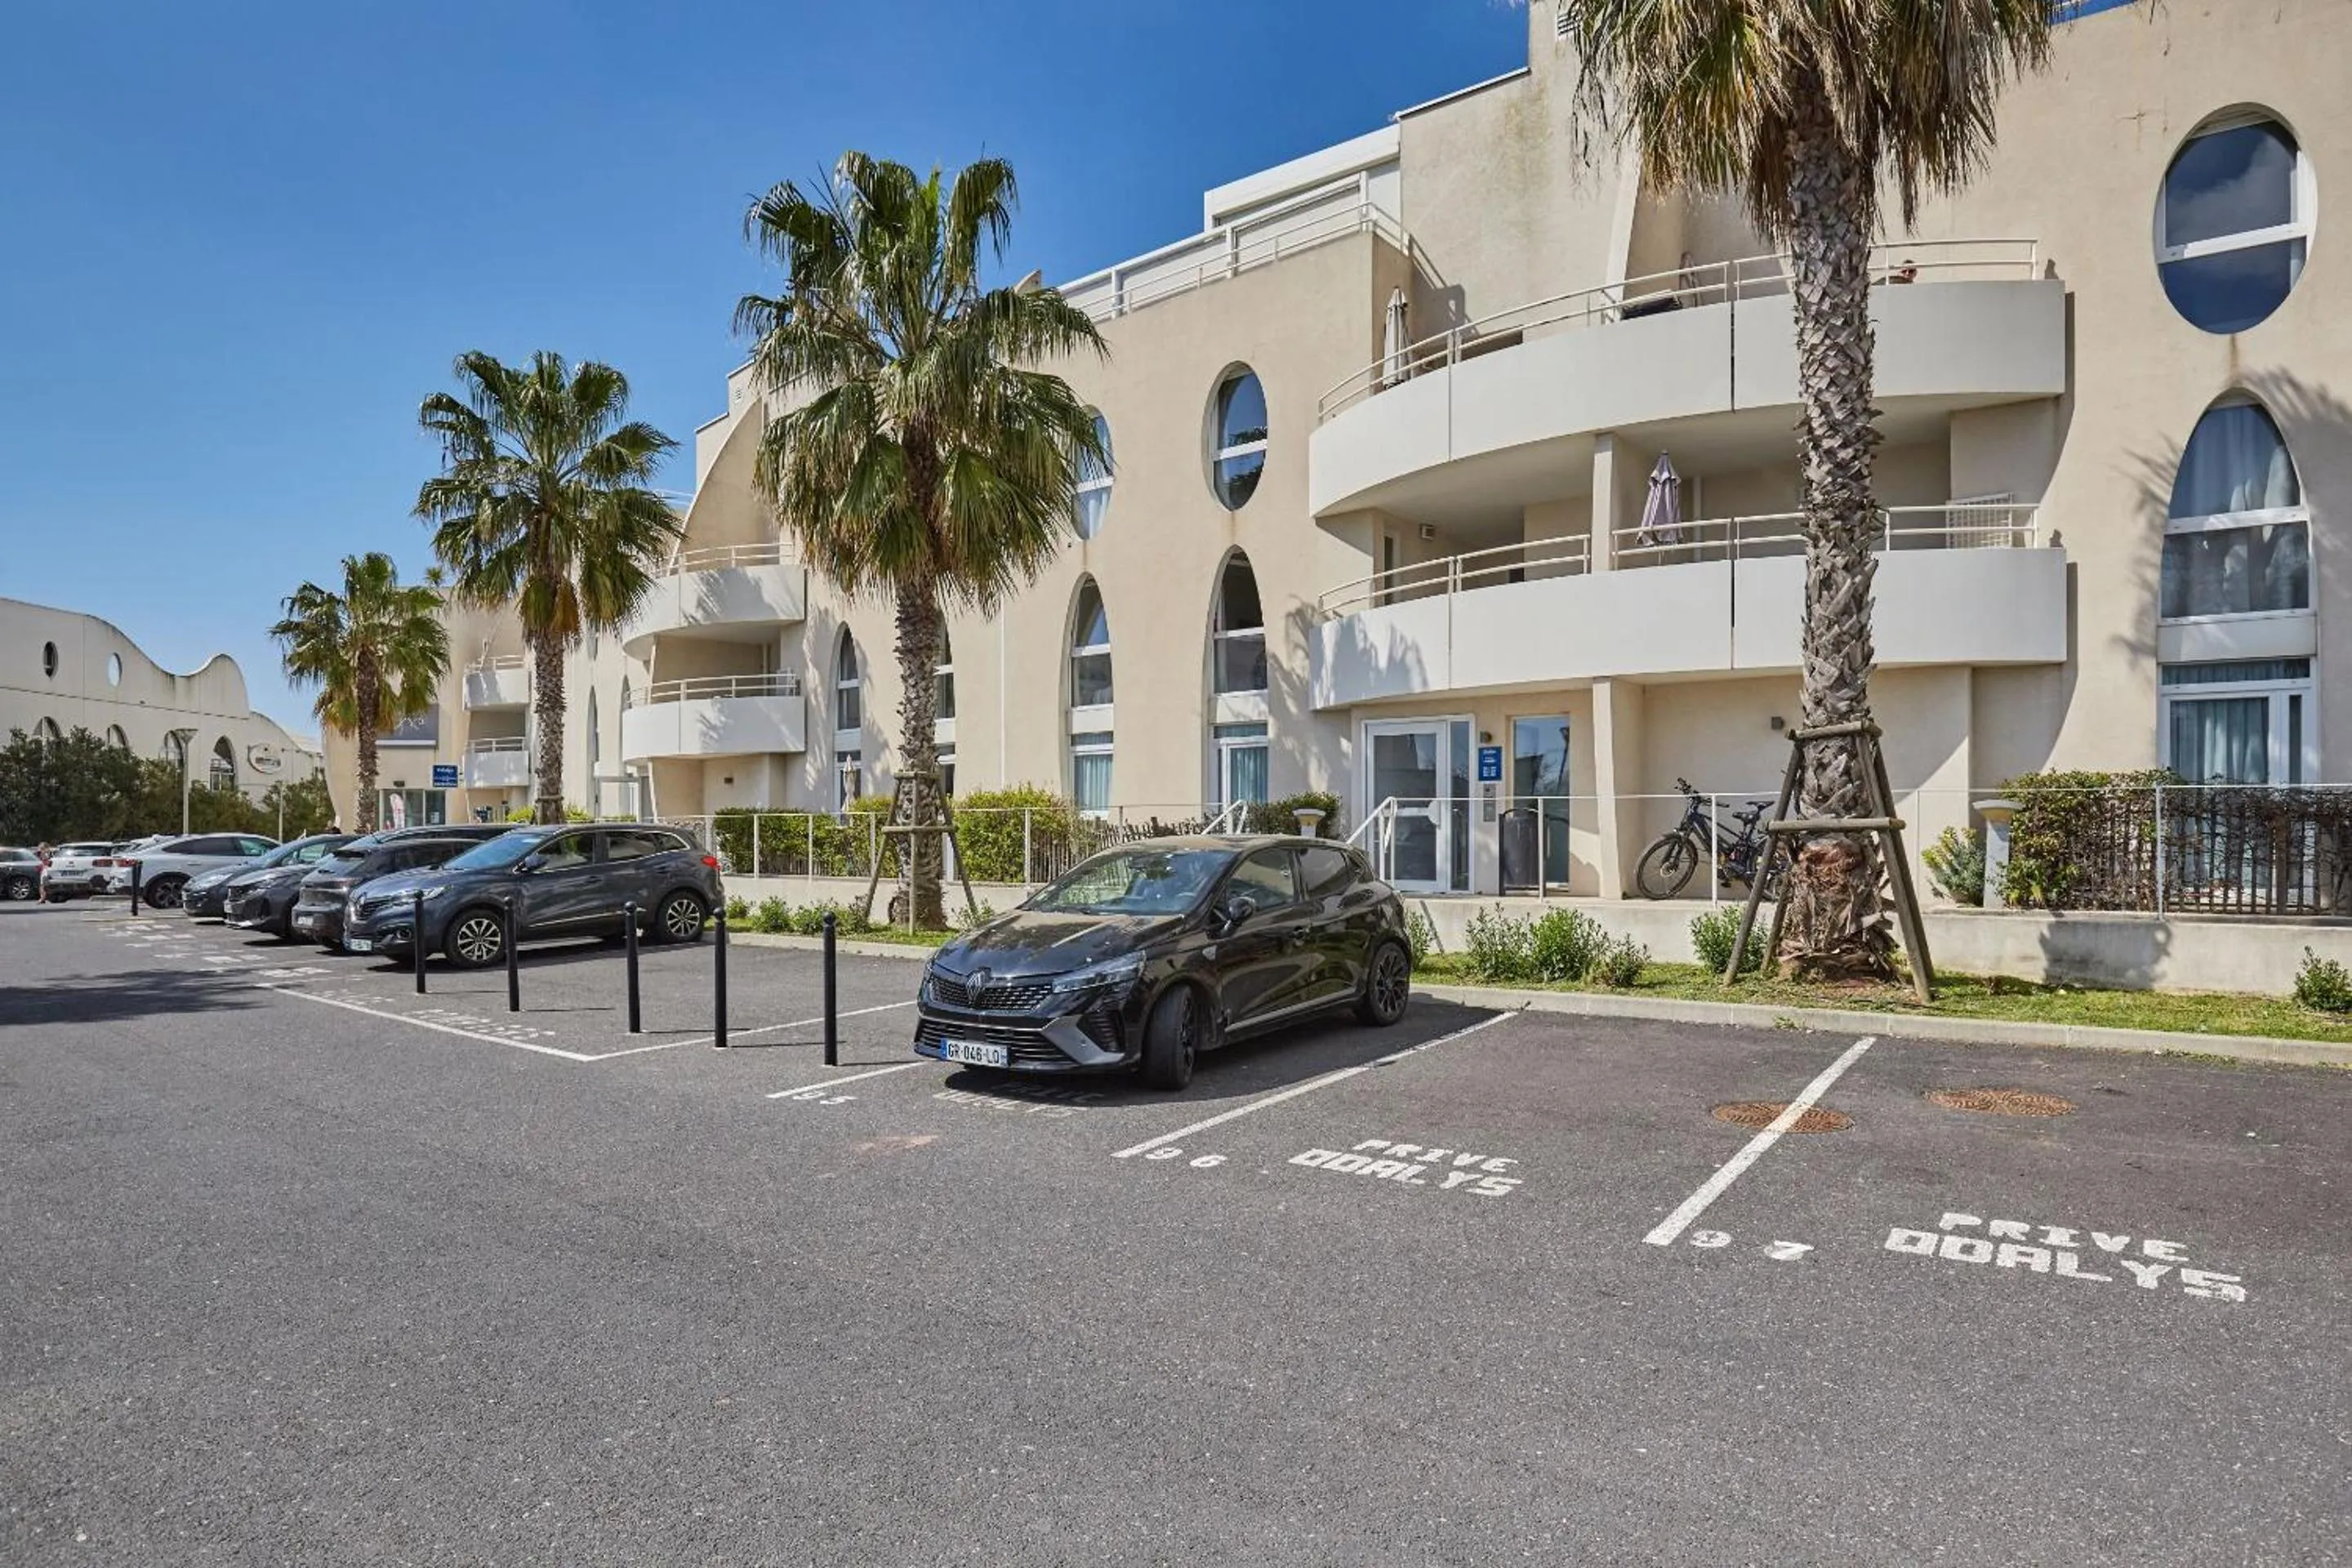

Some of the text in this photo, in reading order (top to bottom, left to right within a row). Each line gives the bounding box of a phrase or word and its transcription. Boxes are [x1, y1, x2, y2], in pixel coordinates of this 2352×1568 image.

[1288, 1147, 1524, 1196] ODALYS
[1939, 1212, 2189, 1261] PRIVE
[1884, 1227, 2247, 1303] ODALYS
